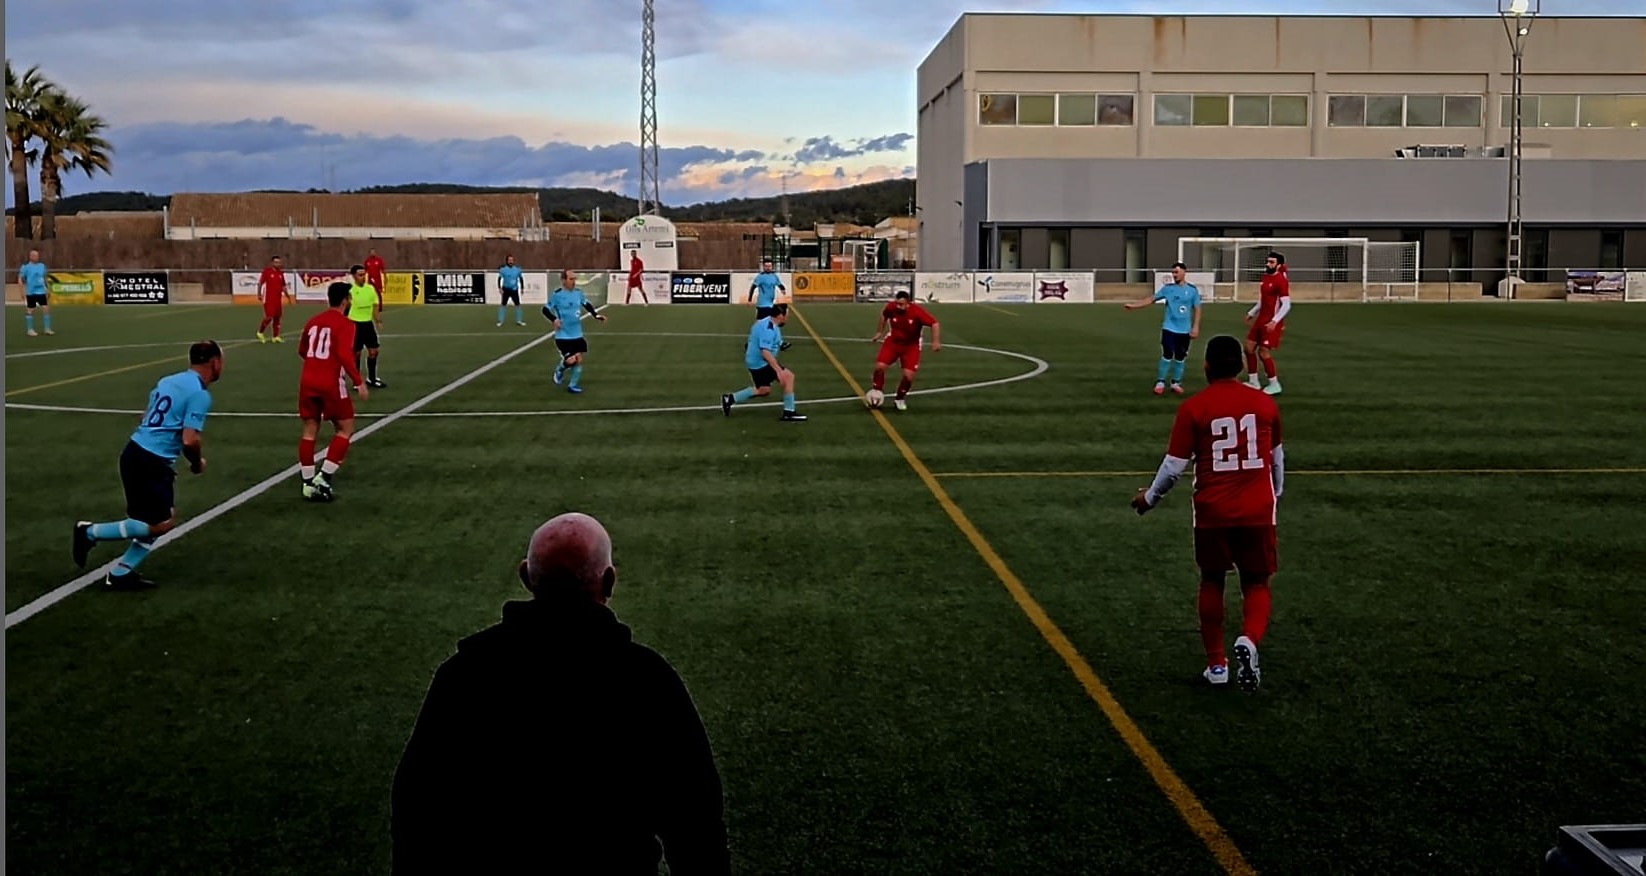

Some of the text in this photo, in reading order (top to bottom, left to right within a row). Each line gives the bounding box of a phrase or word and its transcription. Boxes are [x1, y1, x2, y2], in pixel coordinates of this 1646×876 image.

[673, 284, 728, 293] FIBERVENT
[307, 325, 332, 360] 10
[1210, 413, 1265, 472] 21
